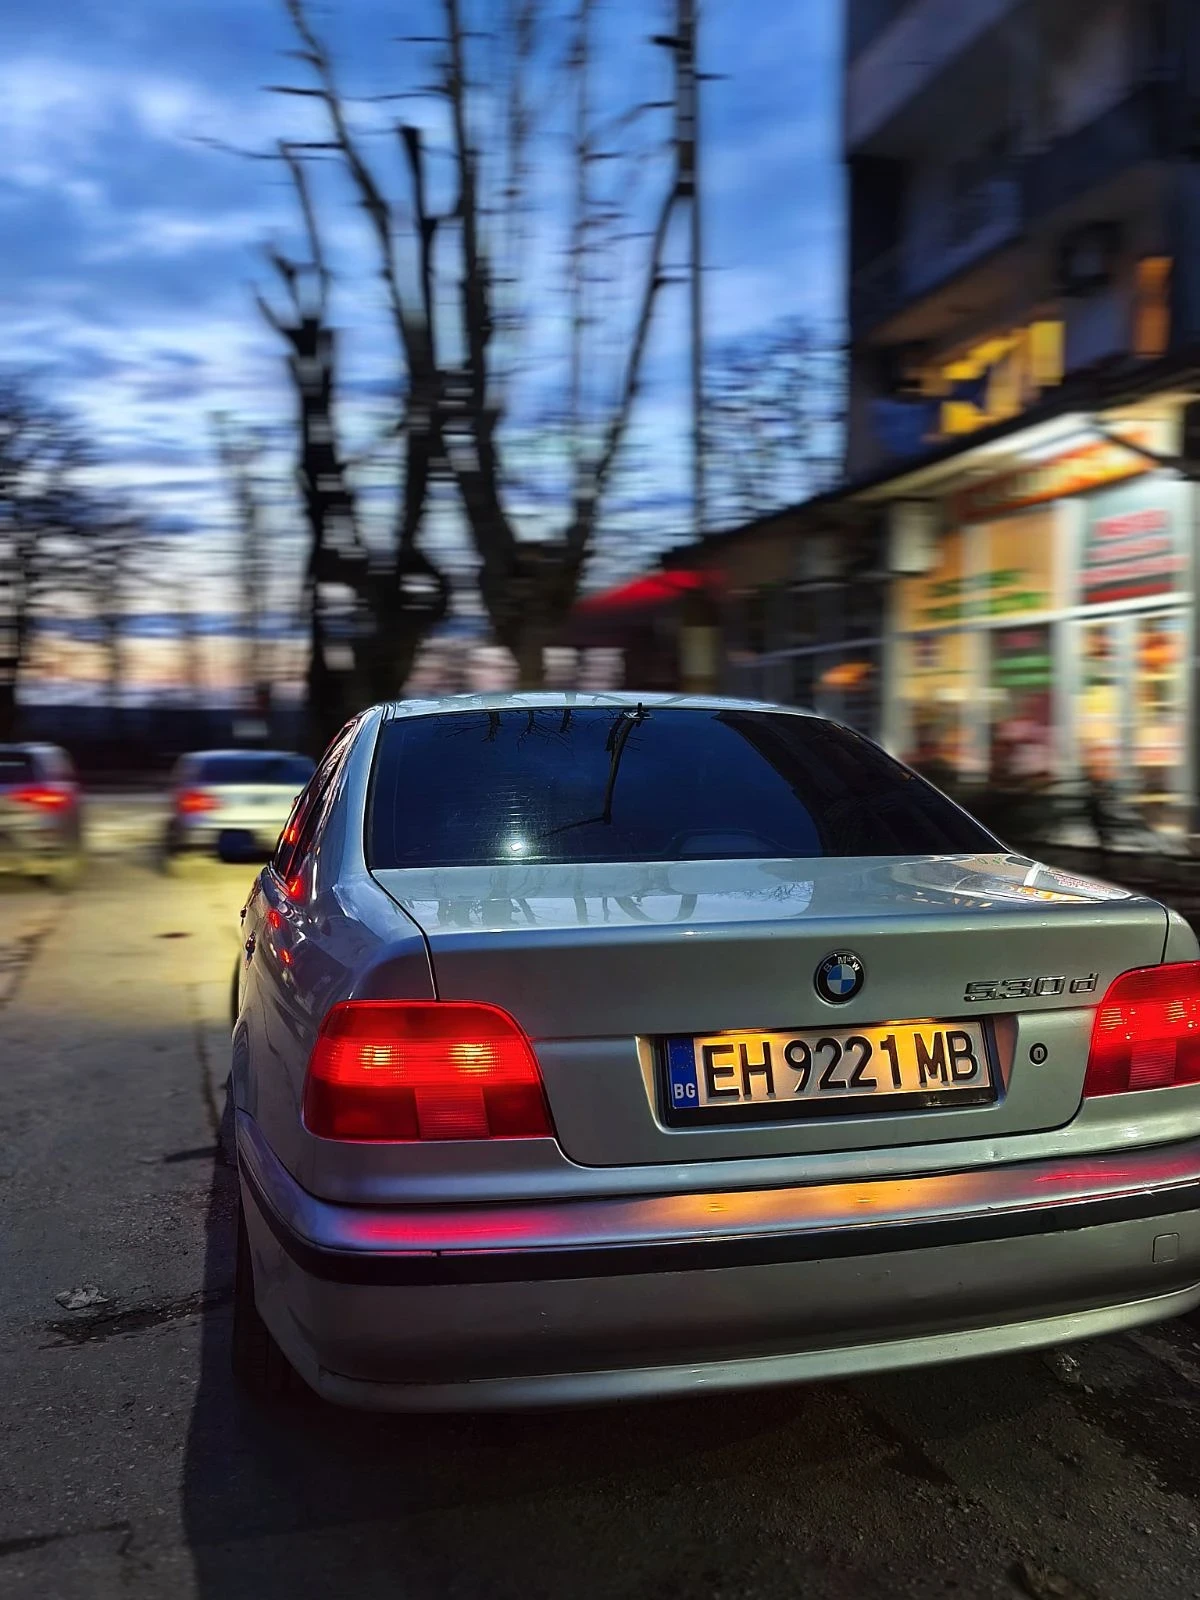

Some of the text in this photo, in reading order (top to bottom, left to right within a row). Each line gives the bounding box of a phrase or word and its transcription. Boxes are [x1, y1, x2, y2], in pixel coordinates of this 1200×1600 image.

[823, 955, 860, 973] BMW
[702, 1030, 977, 1098] EH 9221 MB
[674, 1083, 696, 1099] BG
